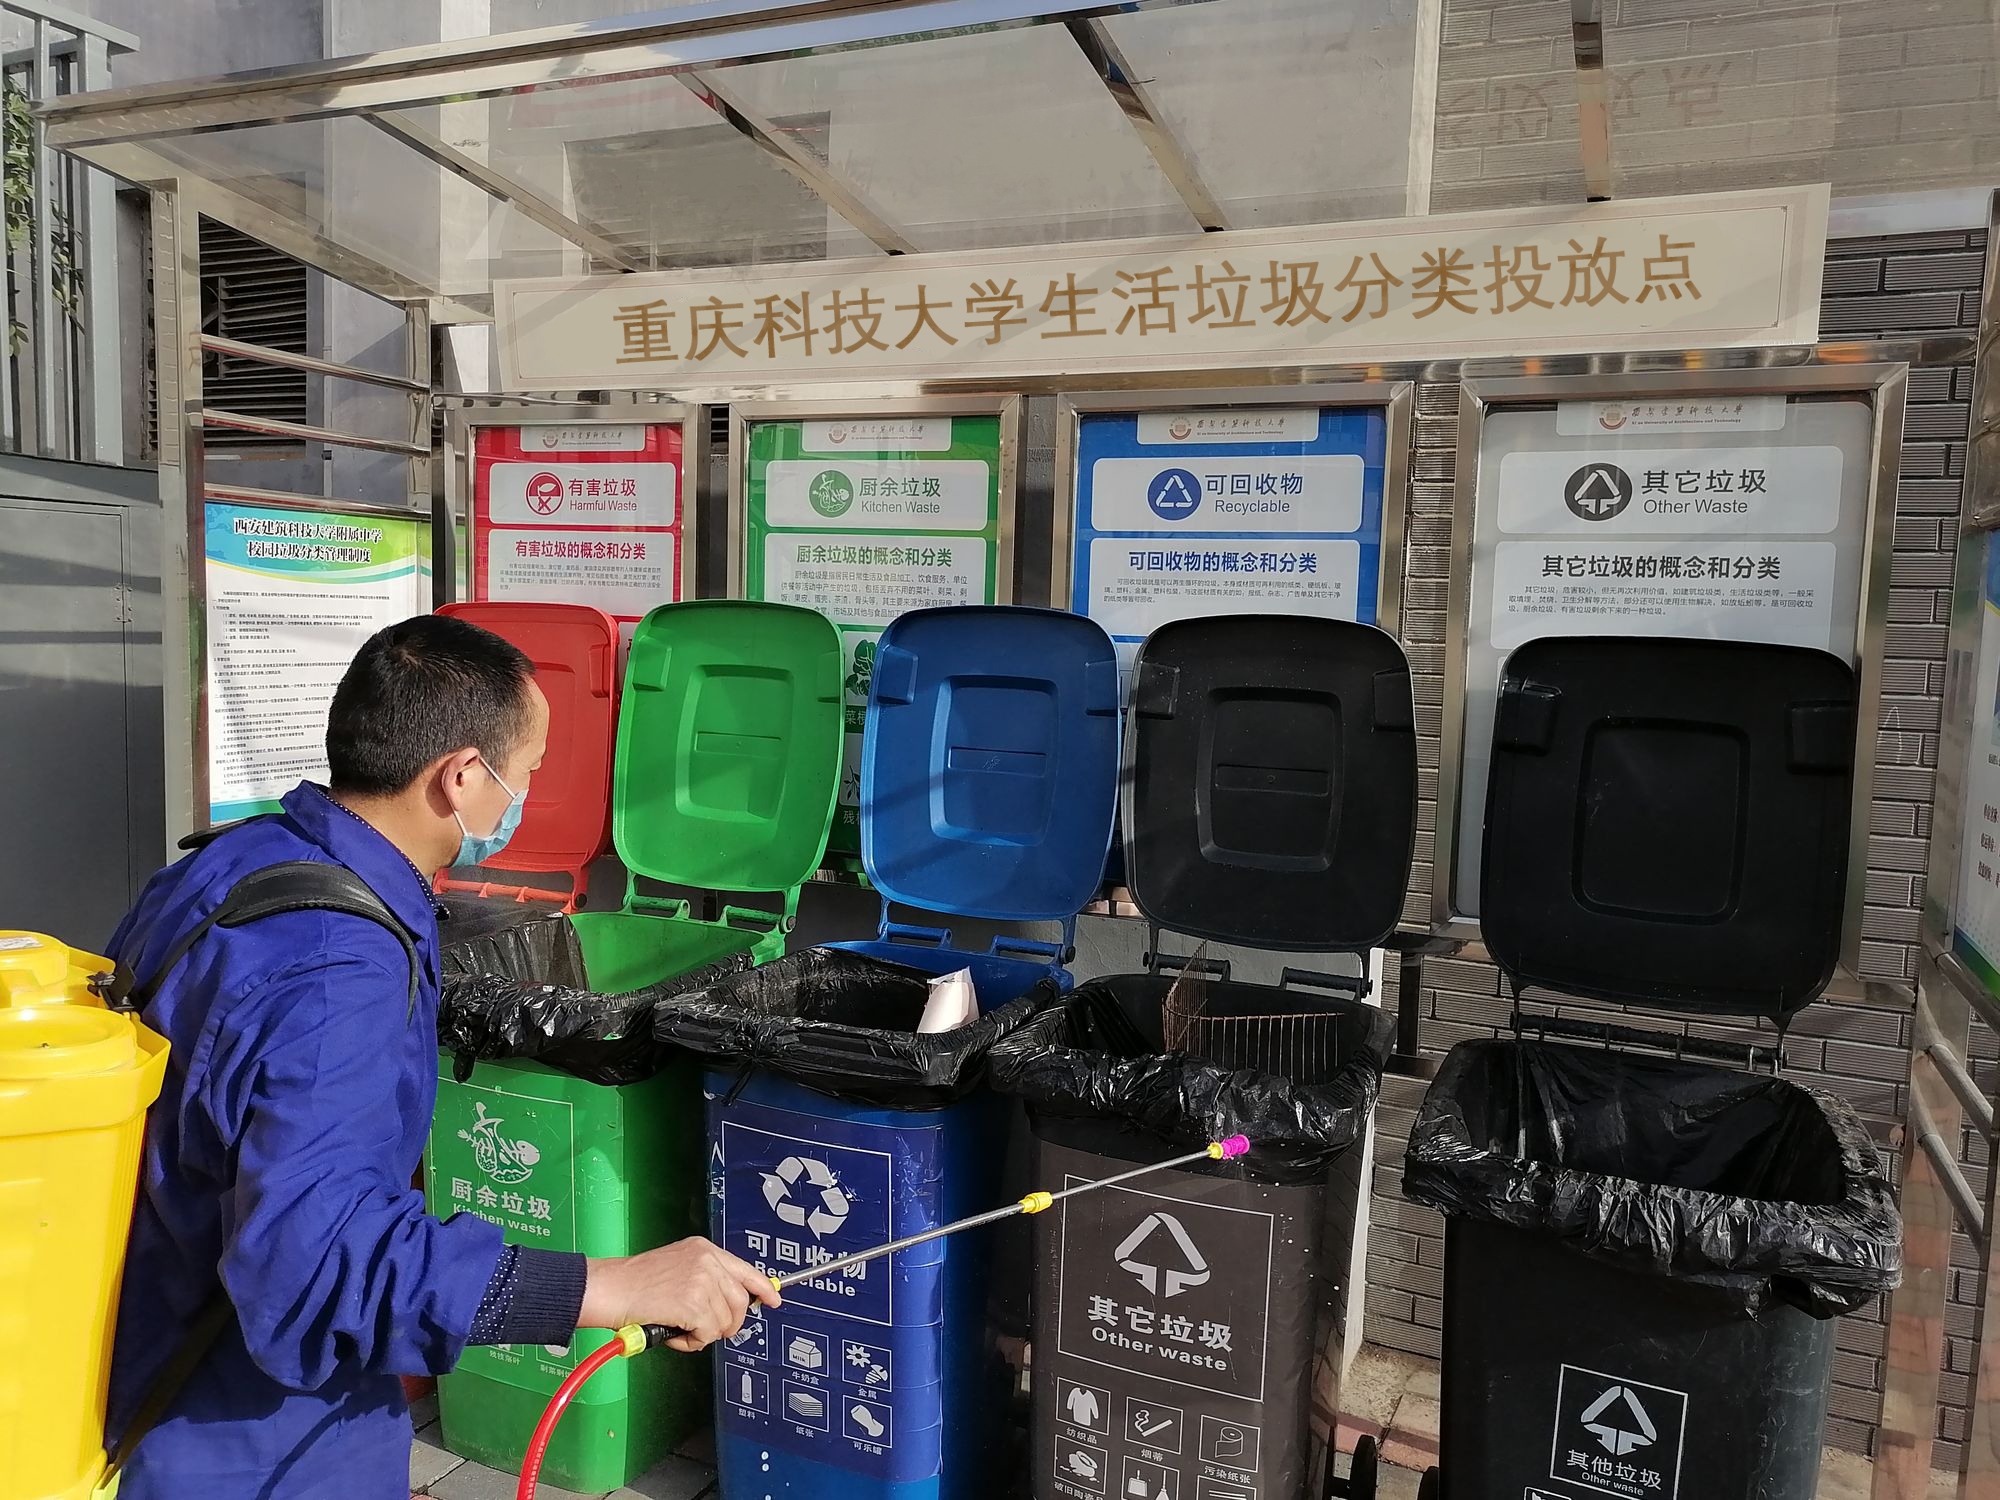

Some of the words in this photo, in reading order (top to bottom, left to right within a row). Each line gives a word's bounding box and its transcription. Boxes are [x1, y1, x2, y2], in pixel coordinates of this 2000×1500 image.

[613, 234, 1702, 365] 重庆科技大学生活垃圾分类投放点
[568, 479, 637, 497] 有害垃圾
[859, 477, 941, 498] 厨余垃圾
[1205, 473, 1303, 495] 可回收物
[1641, 469, 1767, 495] 其它垃圾
[569, 500, 606, 511] Harmful
[607, 500, 637, 511] Waste
[861, 501, 902, 513] Kitchen
[906, 501, 940, 513] Waste
[1214, 498, 1290, 514] Recyclable
[1643, 498, 1690, 514] Other
[1694, 498, 1748, 514] Waste
[233, 518, 382, 543] 西安建筑科技大学附属中学
[248, 541, 371, 562] 校园垃圾分类管理制度
[515, 540, 646, 560] 有害垃圾的概念和分类
[797, 545, 952, 567] 厨余垃圾的概念和分类
[1128, 551, 1317, 573] 可回收物的概念和分类
[1542, 555, 1781, 579] 其它垃圾的概念和分类
[451, 1176, 552, 1222] 厨余垃圾
[508, 1220, 551, 1237] waste
[1087, 1295, 1232, 1352] 其它垃圾
[1091, 1326, 1153, 1354] Other
[1158, 1345, 1227, 1371] waste
[737, 1354, 755, 1366] 玻璃
[792, 1371, 820, 1385] 牛奶盒
[858, 1387, 877, 1400] 金属
[738, 1408, 755, 1420] 塑料
[796, 1425, 814, 1438] 纸张
[1066, 1427, 1097, 1444] 纺织品
[853, 1442, 883, 1456] 可乐罐
[1141, 1448, 1164, 1462] 烟蒂
[1204, 1465, 1251, 1484] 污染纸张
[1567, 1449, 1662, 1491] 其他垃圾
[1581, 1471, 1611, 1487] Other
[1613, 1481, 1644, 1496] waste
